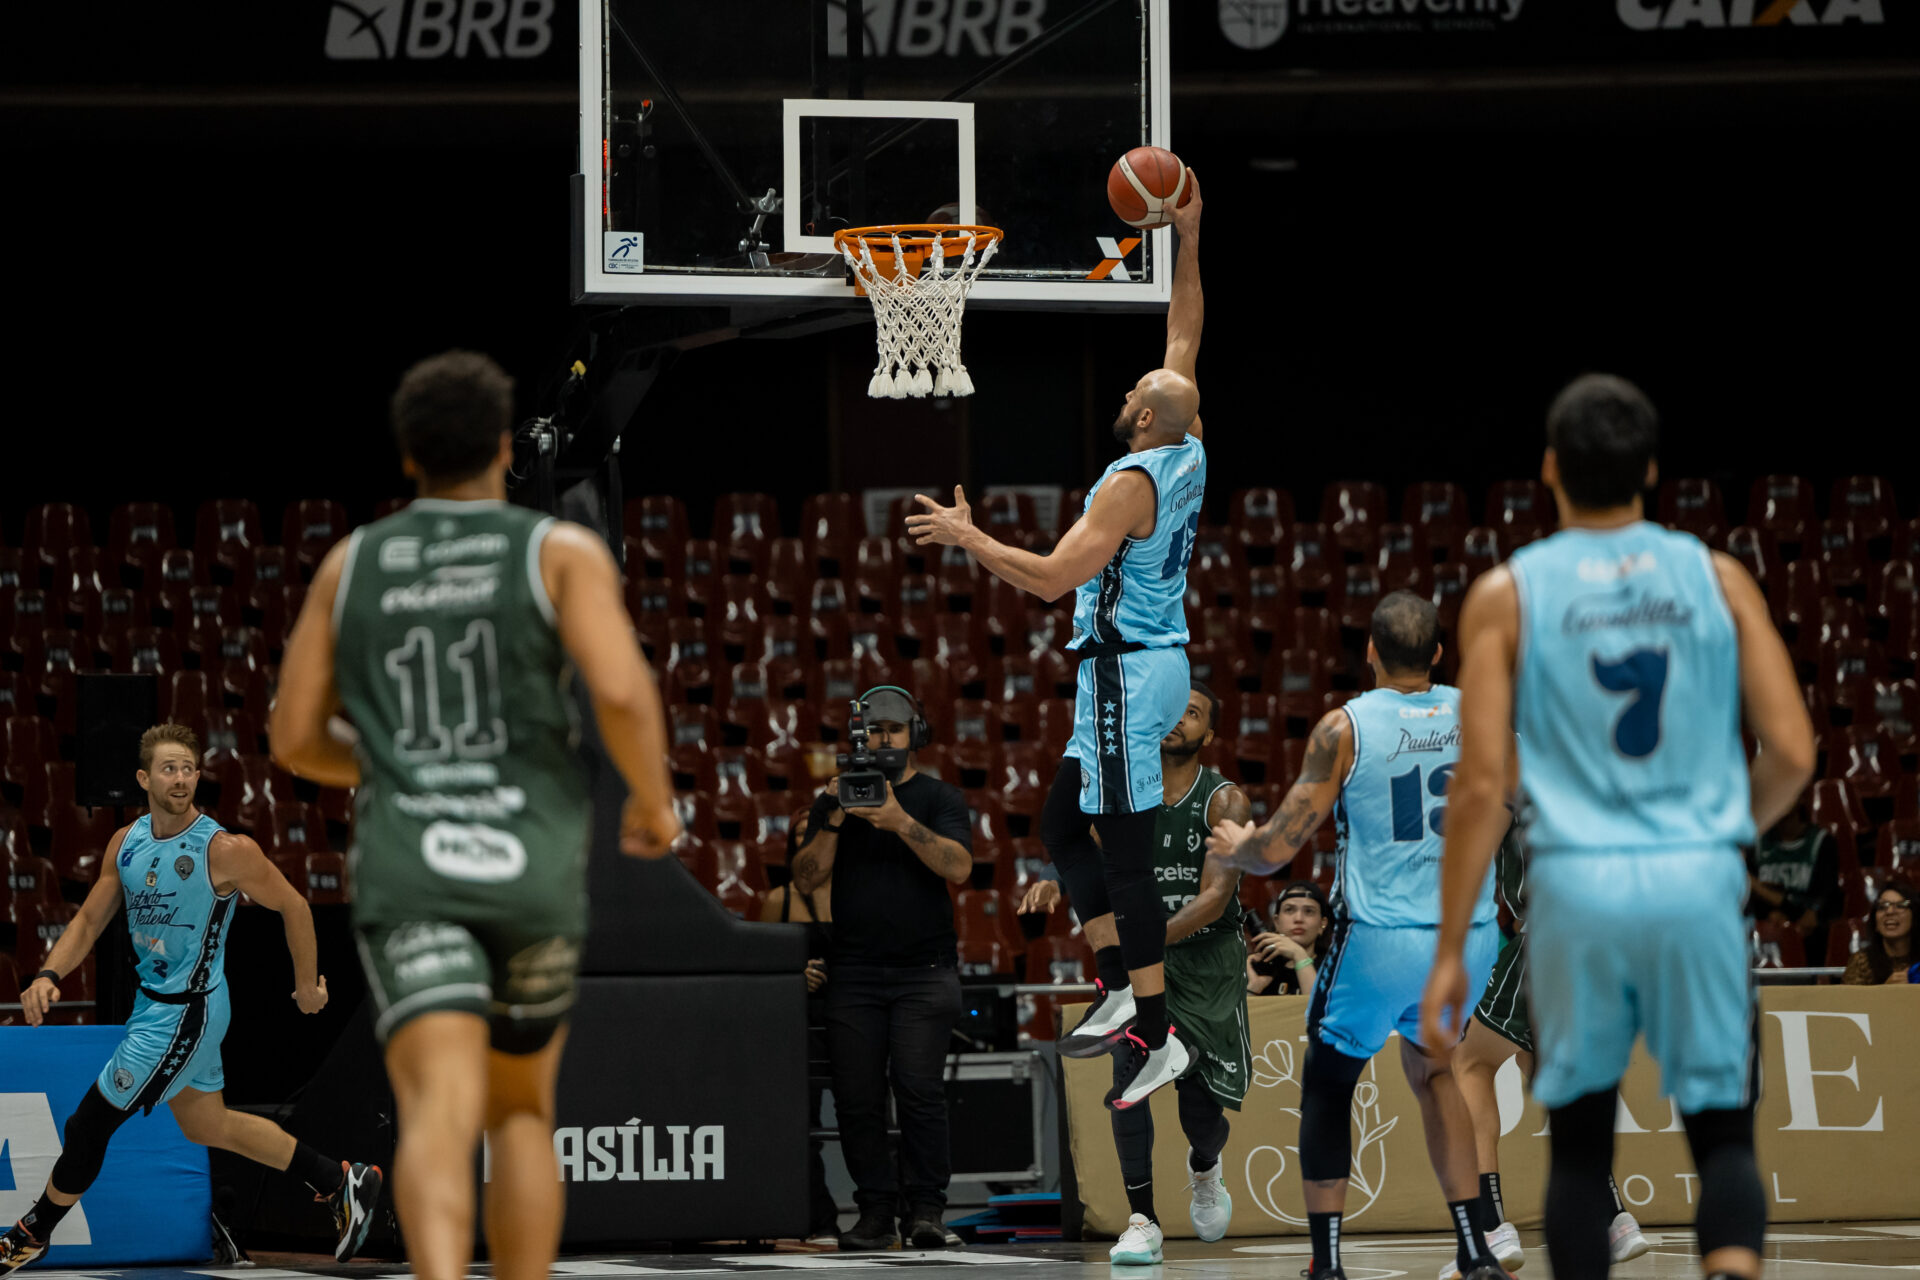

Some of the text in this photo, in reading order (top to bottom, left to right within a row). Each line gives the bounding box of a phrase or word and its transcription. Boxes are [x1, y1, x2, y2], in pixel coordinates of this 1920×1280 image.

[405, 0, 555, 58] BRB
[900, 0, 1047, 56] BRB
[385, 619, 509, 764] 11
[1398, 703, 1453, 719] CAIXA
[1591, 646, 1669, 758] 7
[129, 906, 196, 931] Federal
[152, 959, 169, 979] 2
[484, 1117, 725, 1183] ASÍLIA
[1623, 1172, 1797, 1206] OTL
